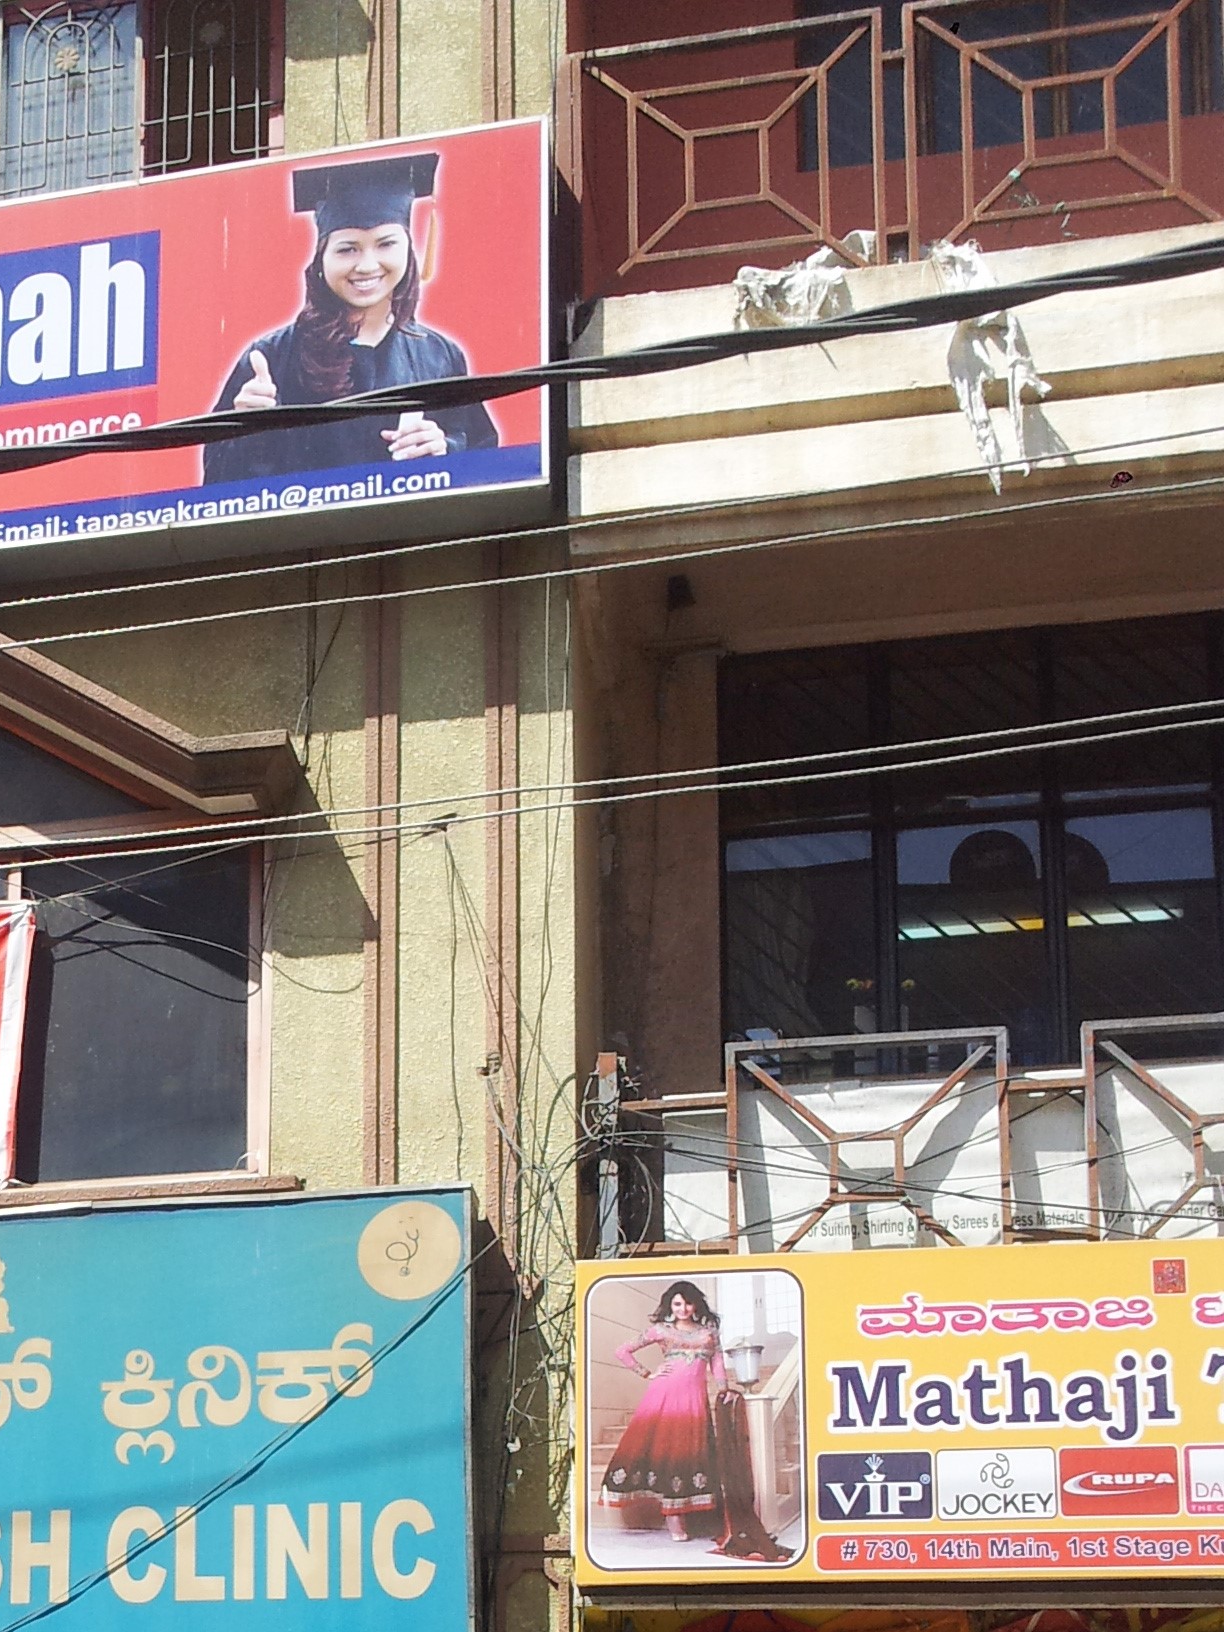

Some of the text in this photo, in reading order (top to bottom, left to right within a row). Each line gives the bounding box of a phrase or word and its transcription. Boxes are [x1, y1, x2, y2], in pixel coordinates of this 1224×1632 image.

[76, 468, 451, 533] tapasyakramah@gmail.com
[864, 1217, 904, 1236] Shirting
[953, 1214, 988, 1230] Sarees
[1011, 1211, 1034, 1227] ress
[1036, 1209, 1084, 1225] Materials
[99, 1322, 376, 1466] ಕ್ಲಿನಿಕ್
[831, 1354, 1176, 1441] Mathaji
[1092, 1472, 1176, 1485] RUPA
[825, 1480, 925, 1515] VIP
[942, 1492, 1053, 1515] JOCKEY
[107, 1497, 437, 1604] CLINIC
[865, 1540, 917, 1564] 730,
[925, 1537, 980, 1560] 14th
[988, 1536, 1058, 1564] Main,
[1070, 1535, 1108, 1558] 1st
[1114, 1535, 1191, 1563] Stage
